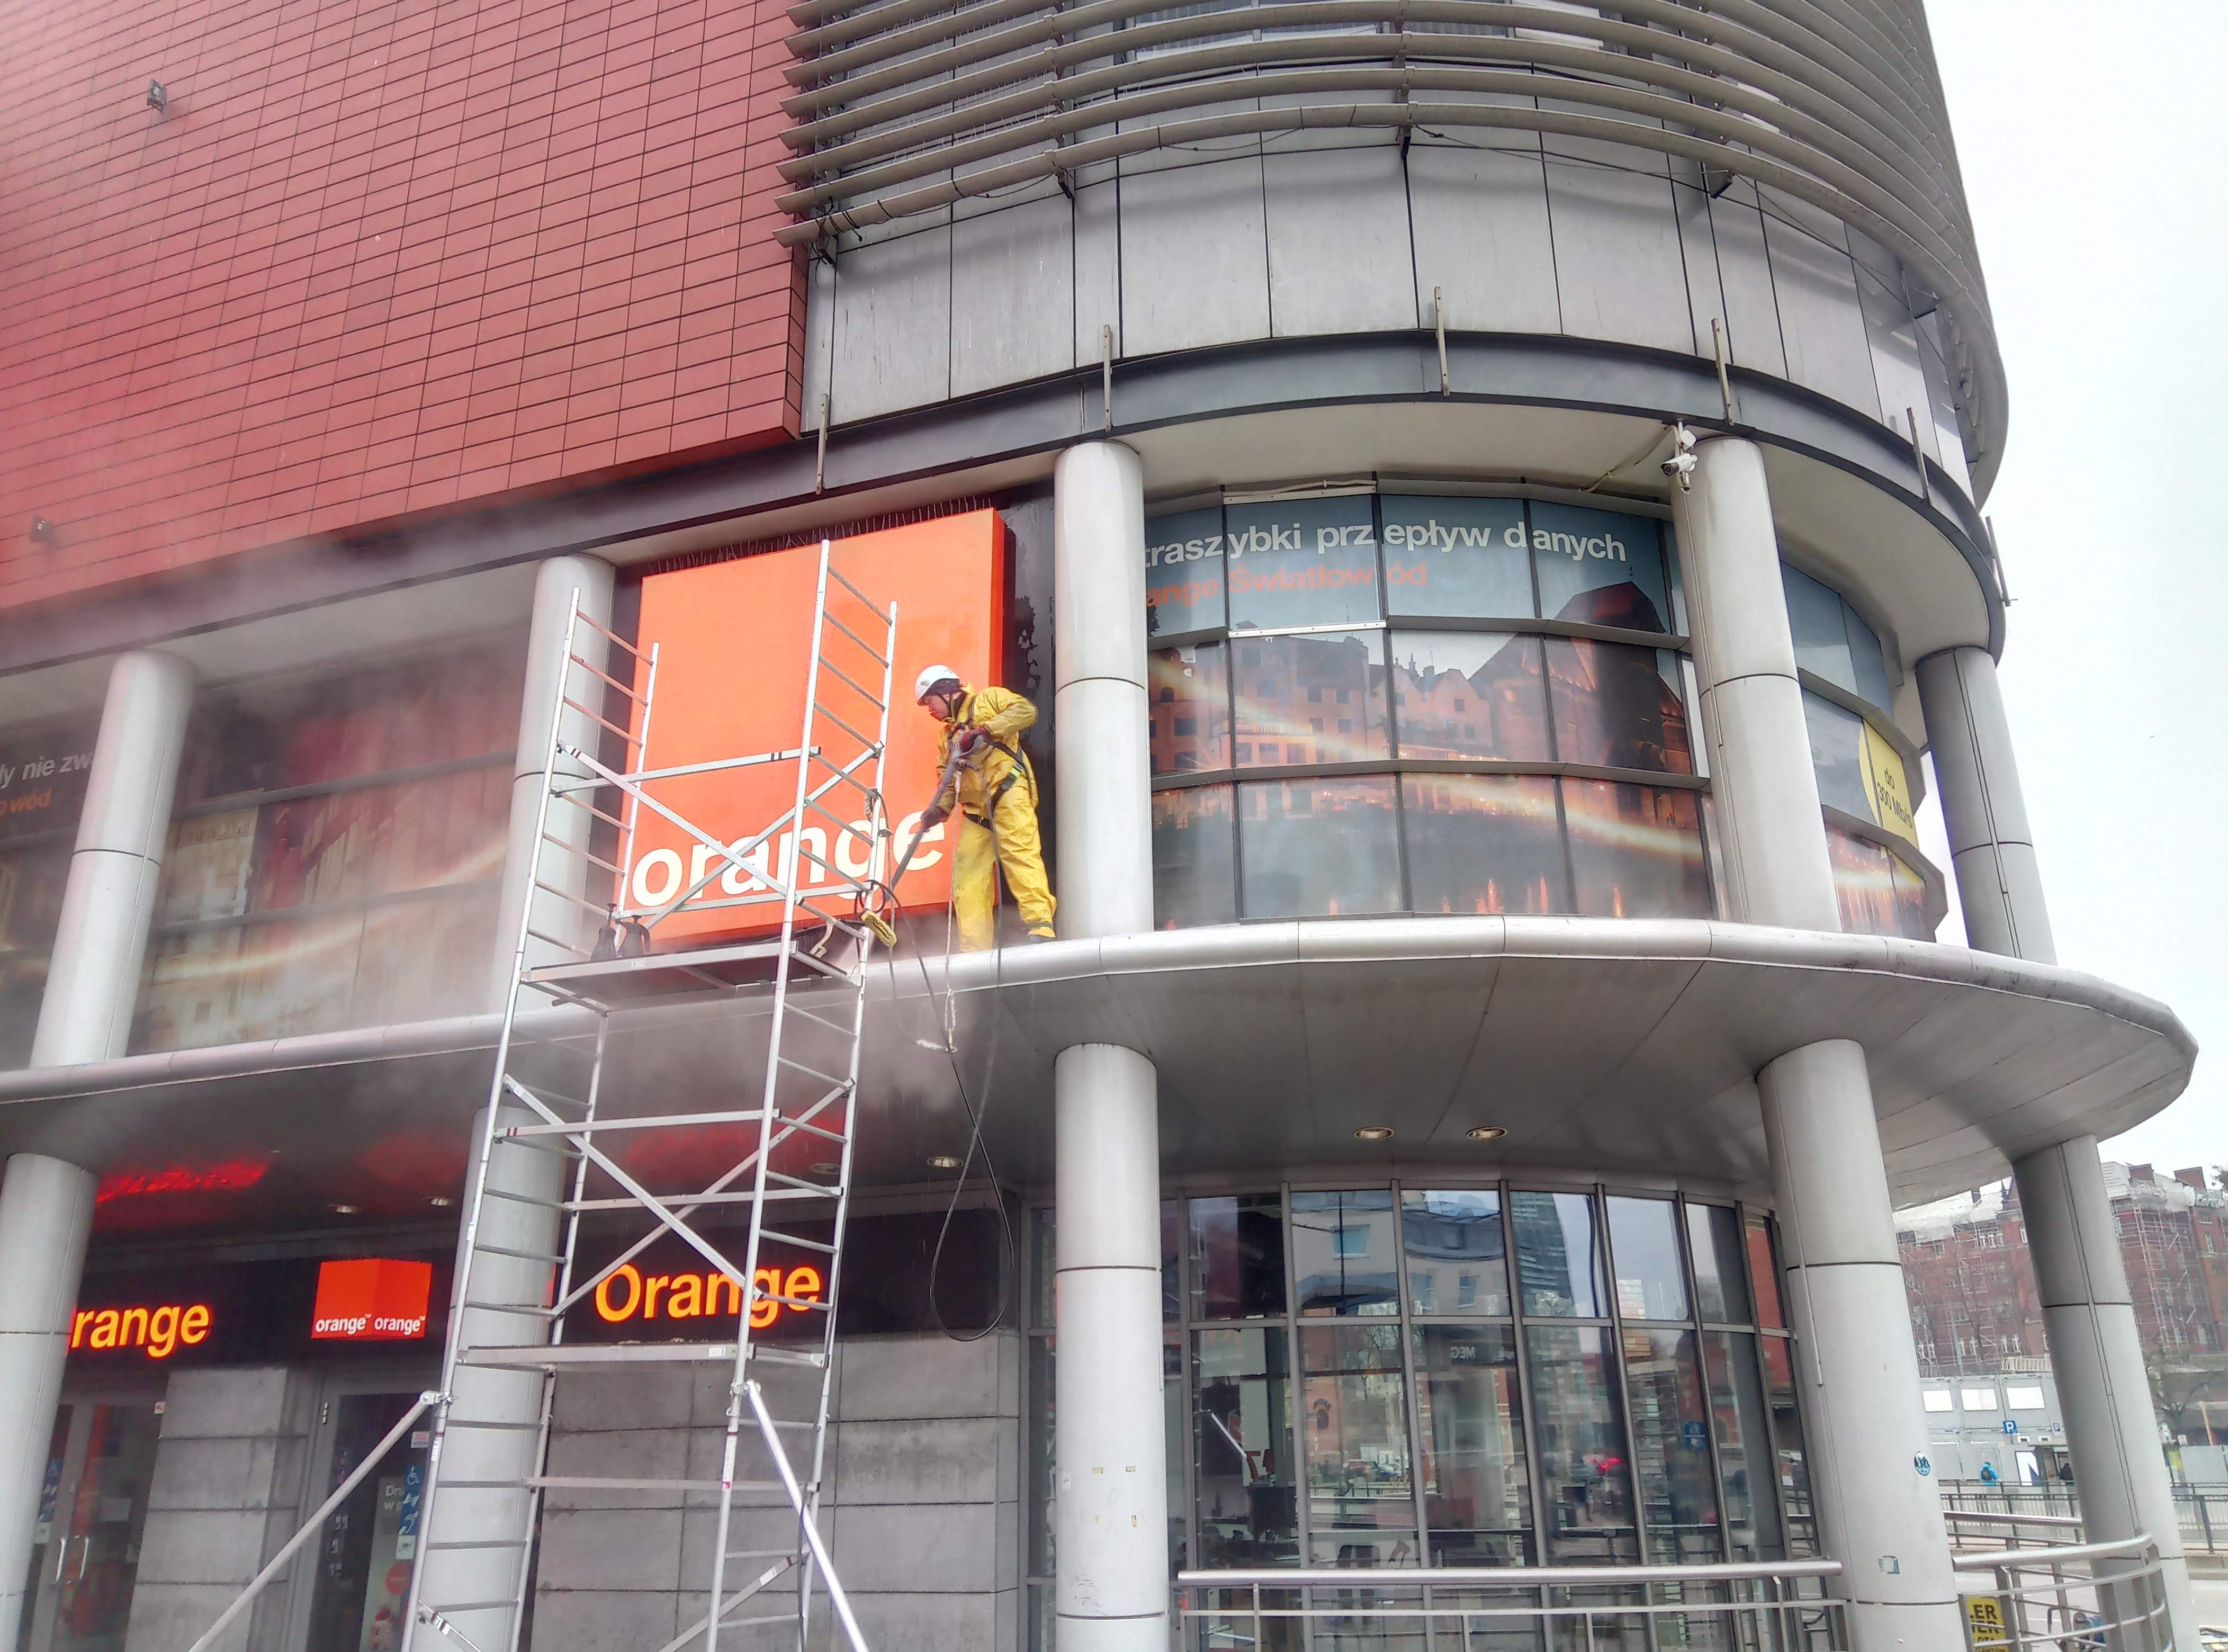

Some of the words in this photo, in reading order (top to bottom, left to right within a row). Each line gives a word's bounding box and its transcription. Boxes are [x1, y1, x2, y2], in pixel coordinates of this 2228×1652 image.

[1317, 519, 1492, 554] przepływ
[1503, 521, 1627, 562] danych
[22, 756, 55, 780] nie
[59, 751, 94, 774] zw
[1884, 767, 1894, 790] do
[1877, 782, 1892, 810] 300
[631, 810, 946, 906] orange
[595, 1263, 821, 1329] Orange
[70, 1304, 210, 1358] range
[315, 1316, 366, 1335] orange
[374, 1317, 421, 1335] orange
[2006, 1421, 2014, 1433] P
